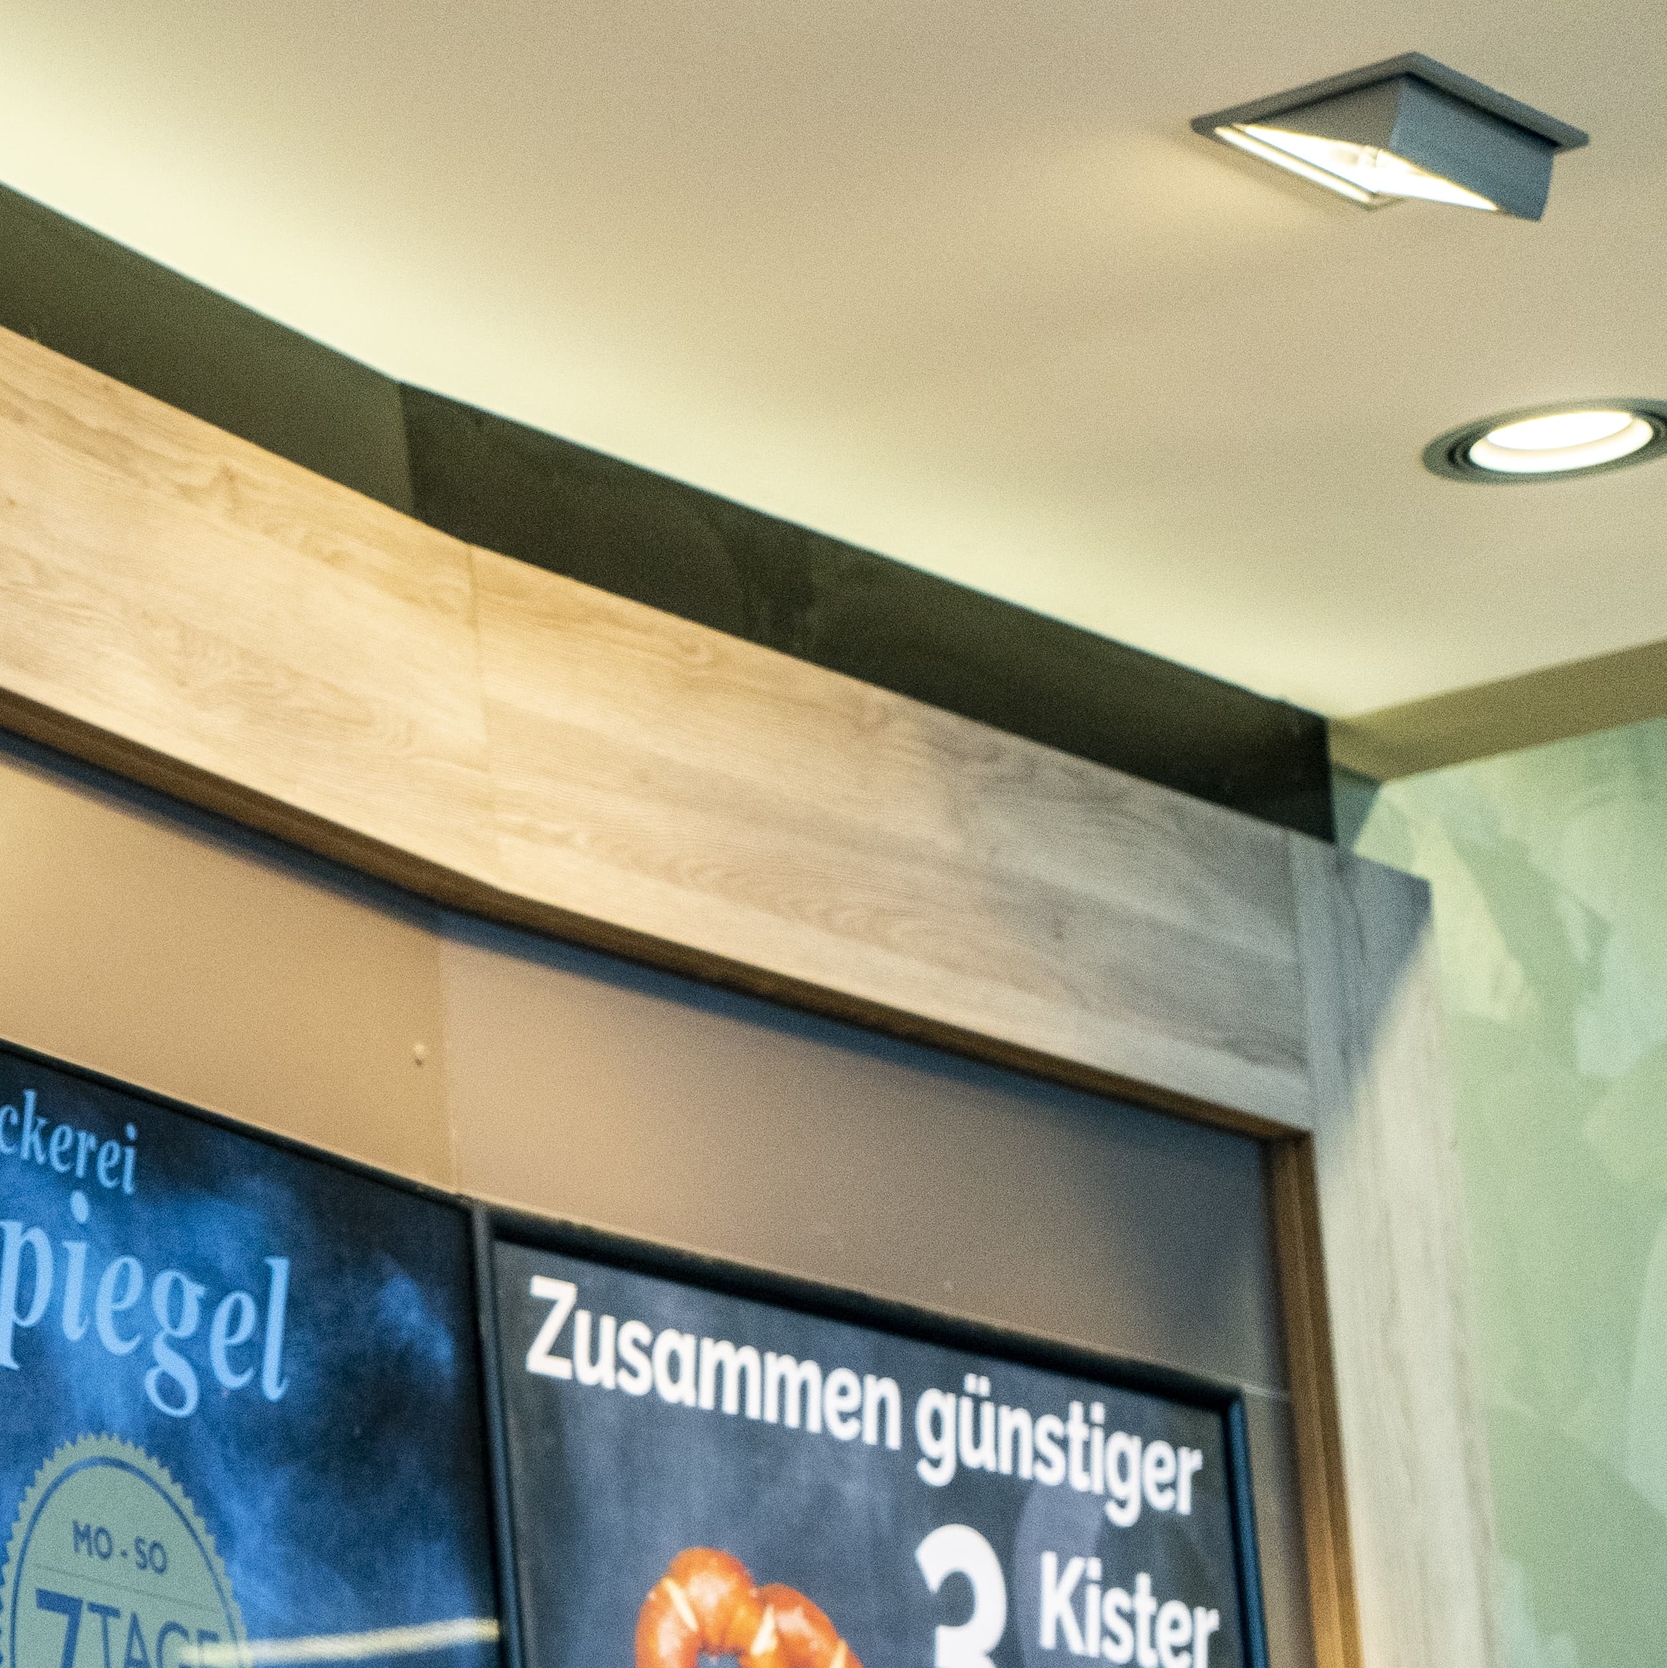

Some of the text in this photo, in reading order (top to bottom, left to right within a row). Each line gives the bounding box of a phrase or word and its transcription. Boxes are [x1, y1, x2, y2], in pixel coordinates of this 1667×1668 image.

[525, 1274, 1204, 1529] Zusammen günstiger
[72, 1520, 113, 1561] MO
[135, 1536, 168, 1575] SO
